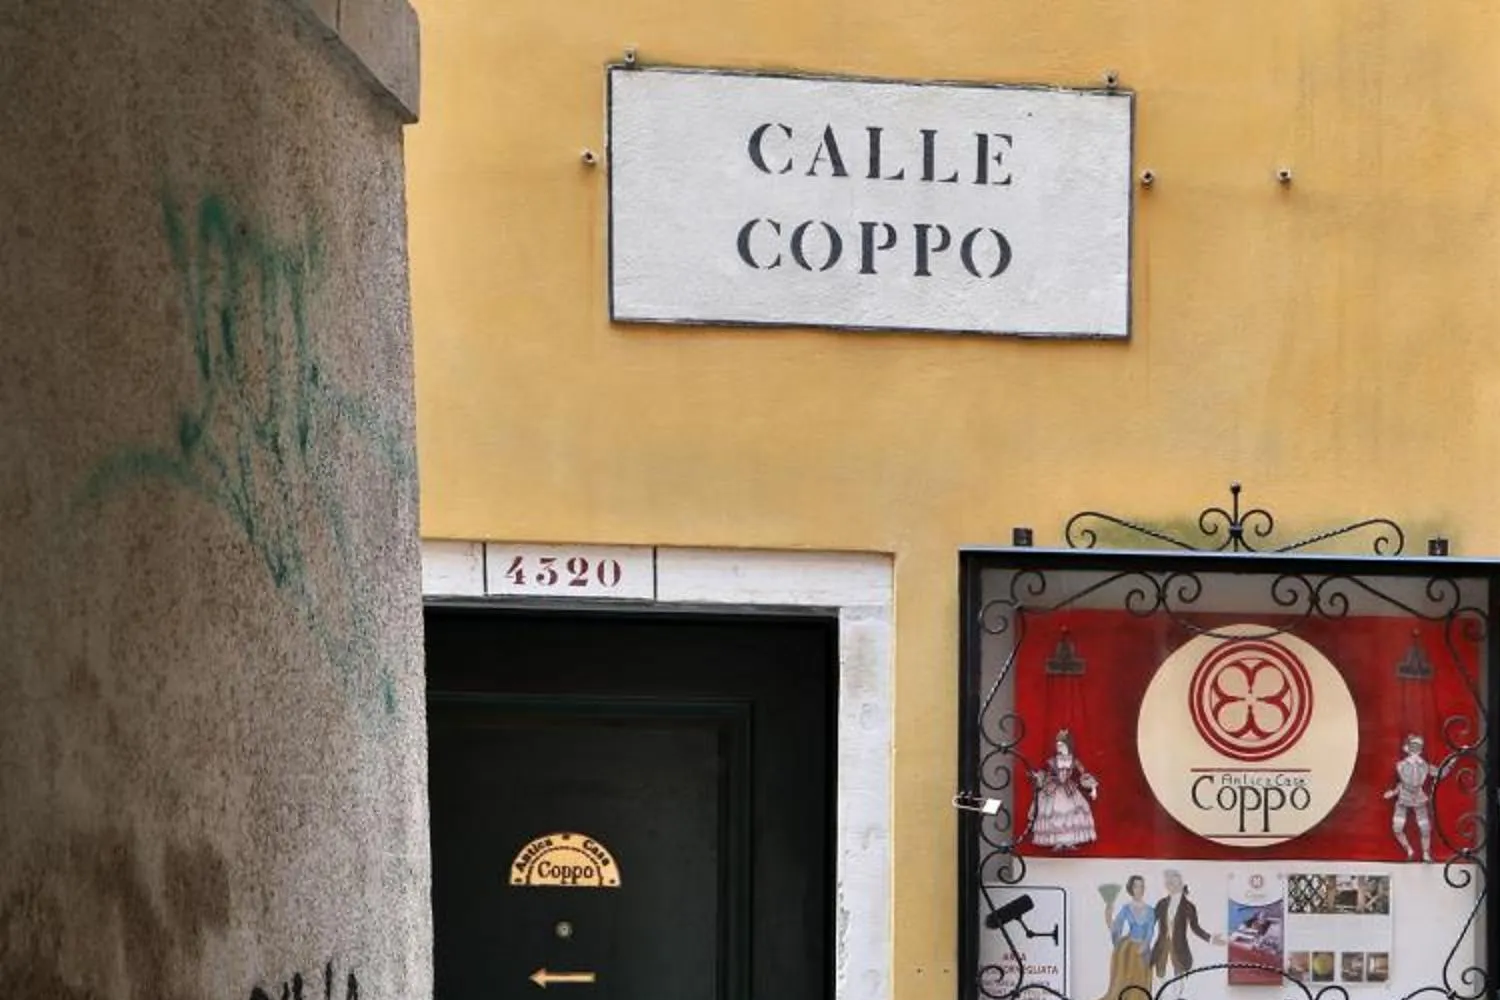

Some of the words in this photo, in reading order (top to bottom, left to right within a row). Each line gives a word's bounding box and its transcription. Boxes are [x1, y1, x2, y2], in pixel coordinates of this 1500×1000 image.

[748, 122, 1013, 186] CALLE
[736, 217, 1013, 279] COPPO
[504, 555, 622, 587] 4320
[1191, 774, 1311, 833] Coppo
[537, 861, 594, 885] Coppo
[583, 839, 610, 867] Casa
